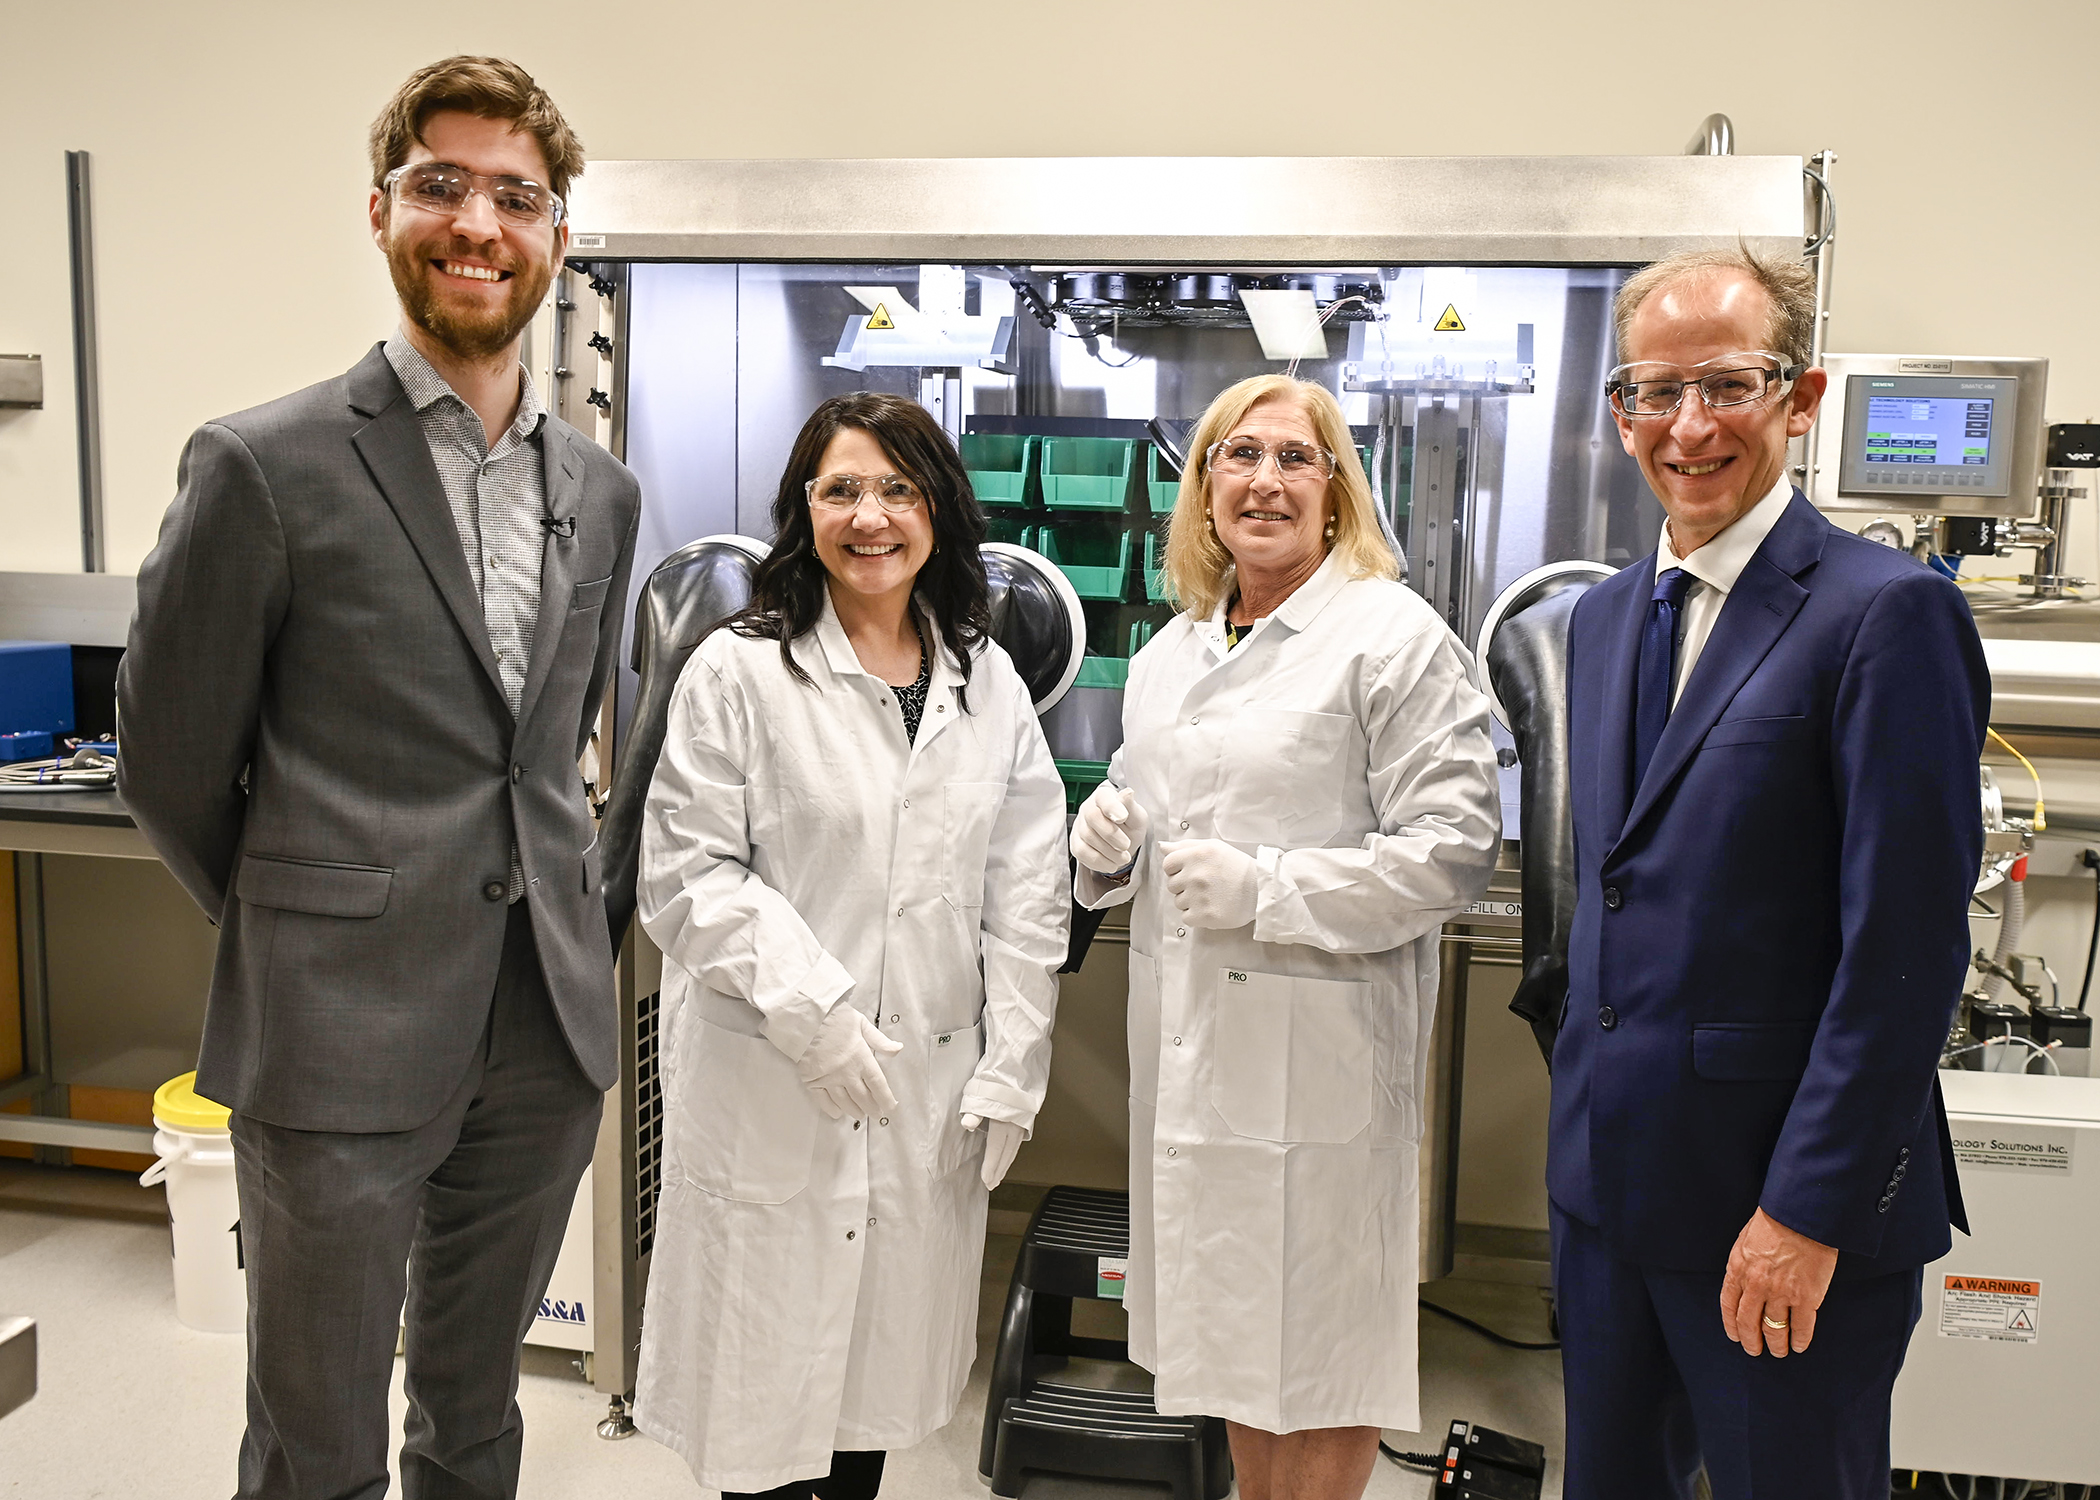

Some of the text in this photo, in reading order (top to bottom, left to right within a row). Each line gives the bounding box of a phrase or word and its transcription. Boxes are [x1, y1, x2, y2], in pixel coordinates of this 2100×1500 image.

[2066, 452, 2094, 461] VAT
[1464, 902, 1498, 914] FILL
[1228, 971, 1247, 982] PRO
[938, 1034, 951, 1044] PRO
[1953, 1139, 1986, 1149] OLOGY
[1991, 1139, 2043, 1152] SOLUTIONS
[1966, 1279, 2031, 1294] WARNING
[537, 1298, 586, 1322] S&A
